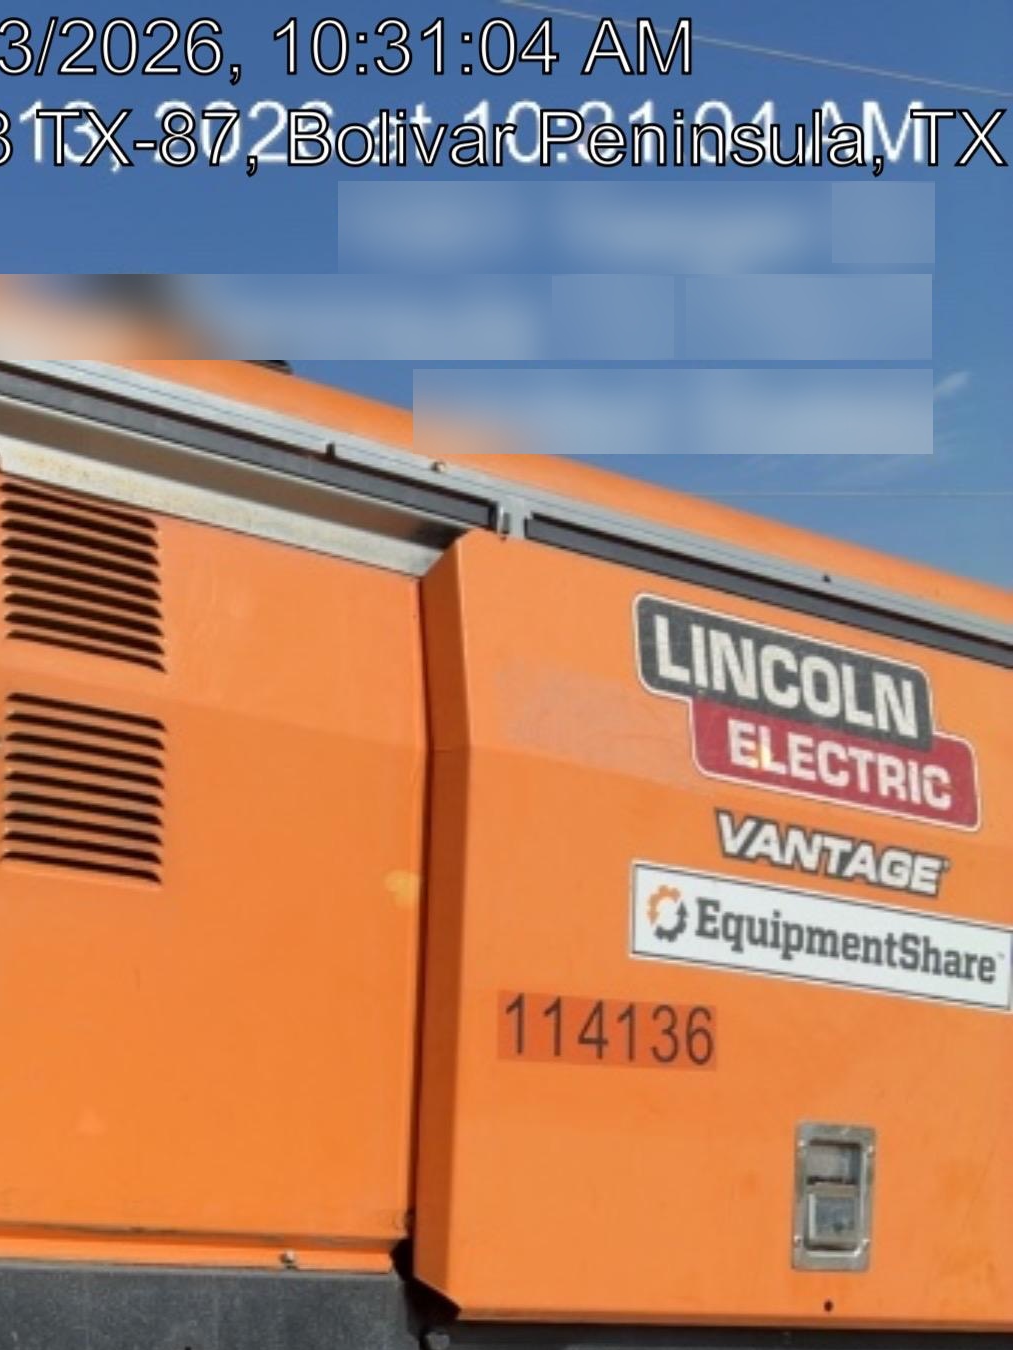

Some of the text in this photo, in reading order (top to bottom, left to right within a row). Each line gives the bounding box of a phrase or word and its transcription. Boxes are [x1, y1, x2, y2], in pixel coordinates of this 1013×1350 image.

[653, 614, 918, 739] LINCOLN
[727, 719, 953, 811] ELECTRIC
[715, 808, 943, 899] VANTAGE
[695, 897, 997, 984] EquipmentShare
[504, 993, 715, 1066] 114136
